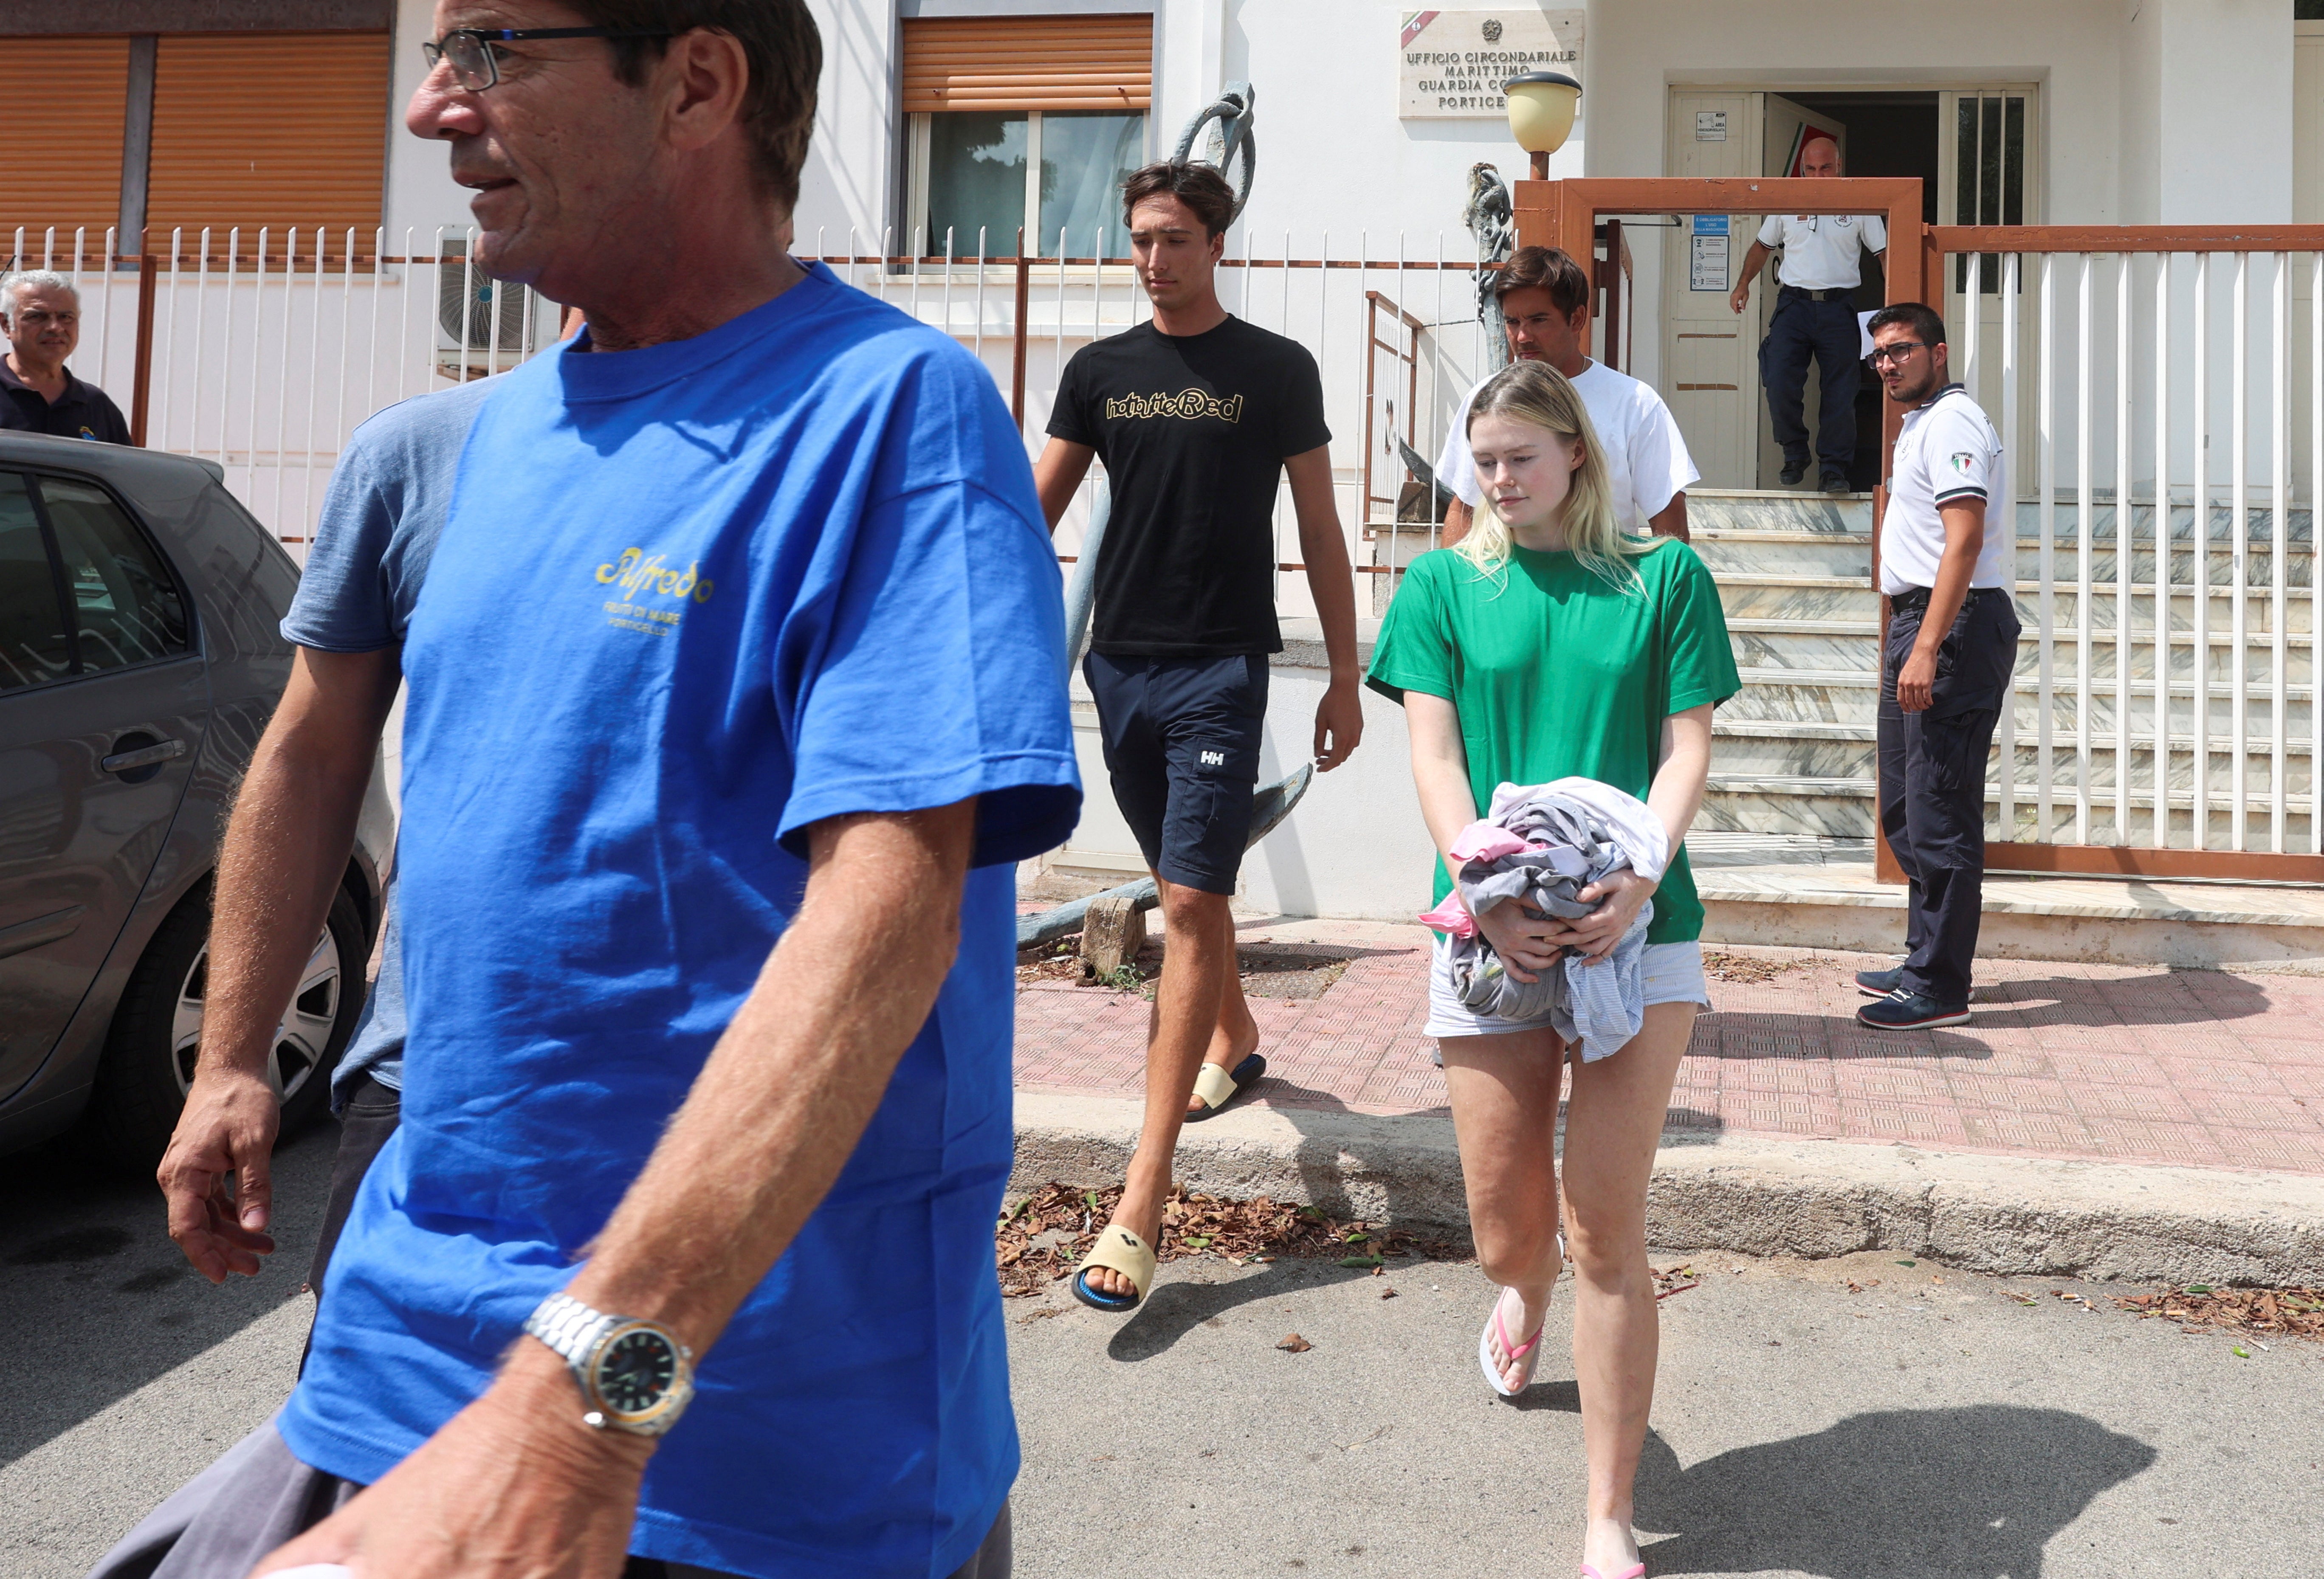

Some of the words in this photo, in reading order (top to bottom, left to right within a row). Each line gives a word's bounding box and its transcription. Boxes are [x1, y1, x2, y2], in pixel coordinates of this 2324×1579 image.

[1407, 53, 1460, 63] UFFICIO
[1465, 51, 1576, 62] CIRCONDARIALE
[1445, 65, 1530, 76] MARITTIMO
[1419, 79, 1482, 90] GUARDIA
[1438, 97, 1505, 107] PORTICE
[595, 546, 714, 604] Alfredo
[1200, 750, 1224, 766] HH
